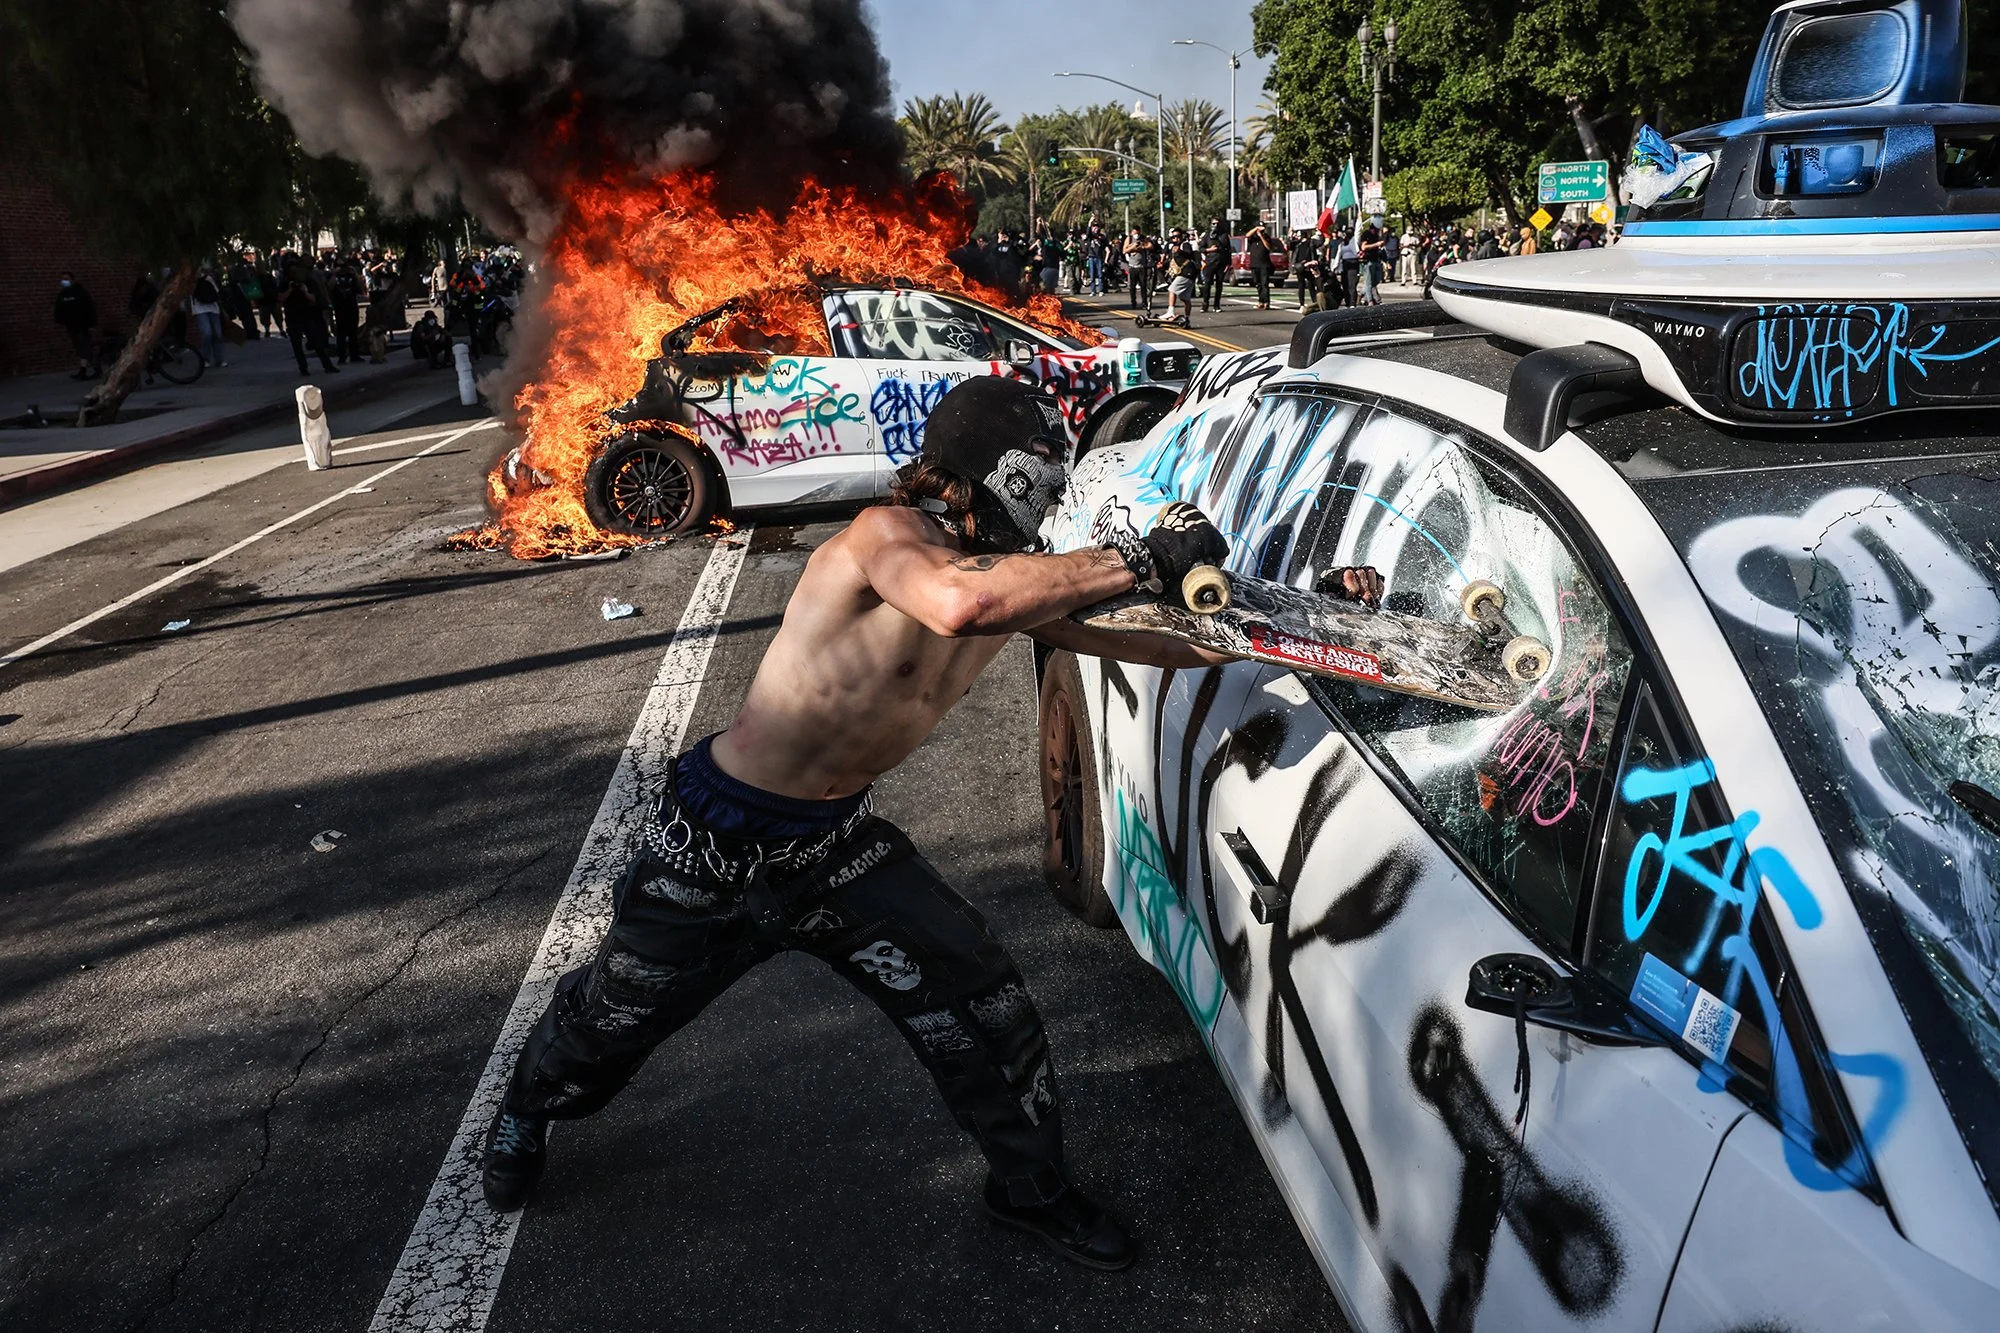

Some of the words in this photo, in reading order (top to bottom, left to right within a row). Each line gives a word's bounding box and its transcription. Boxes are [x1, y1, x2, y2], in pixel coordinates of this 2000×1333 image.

[1561, 165, 1591, 173] NORTH
[1560, 190, 1589, 198] SOUTH
[1654, 321, 1705, 338] WAYMO
[1279, 643, 1379, 676] SKATESHOP
[1326, 647, 1378, 668] ANGEL
